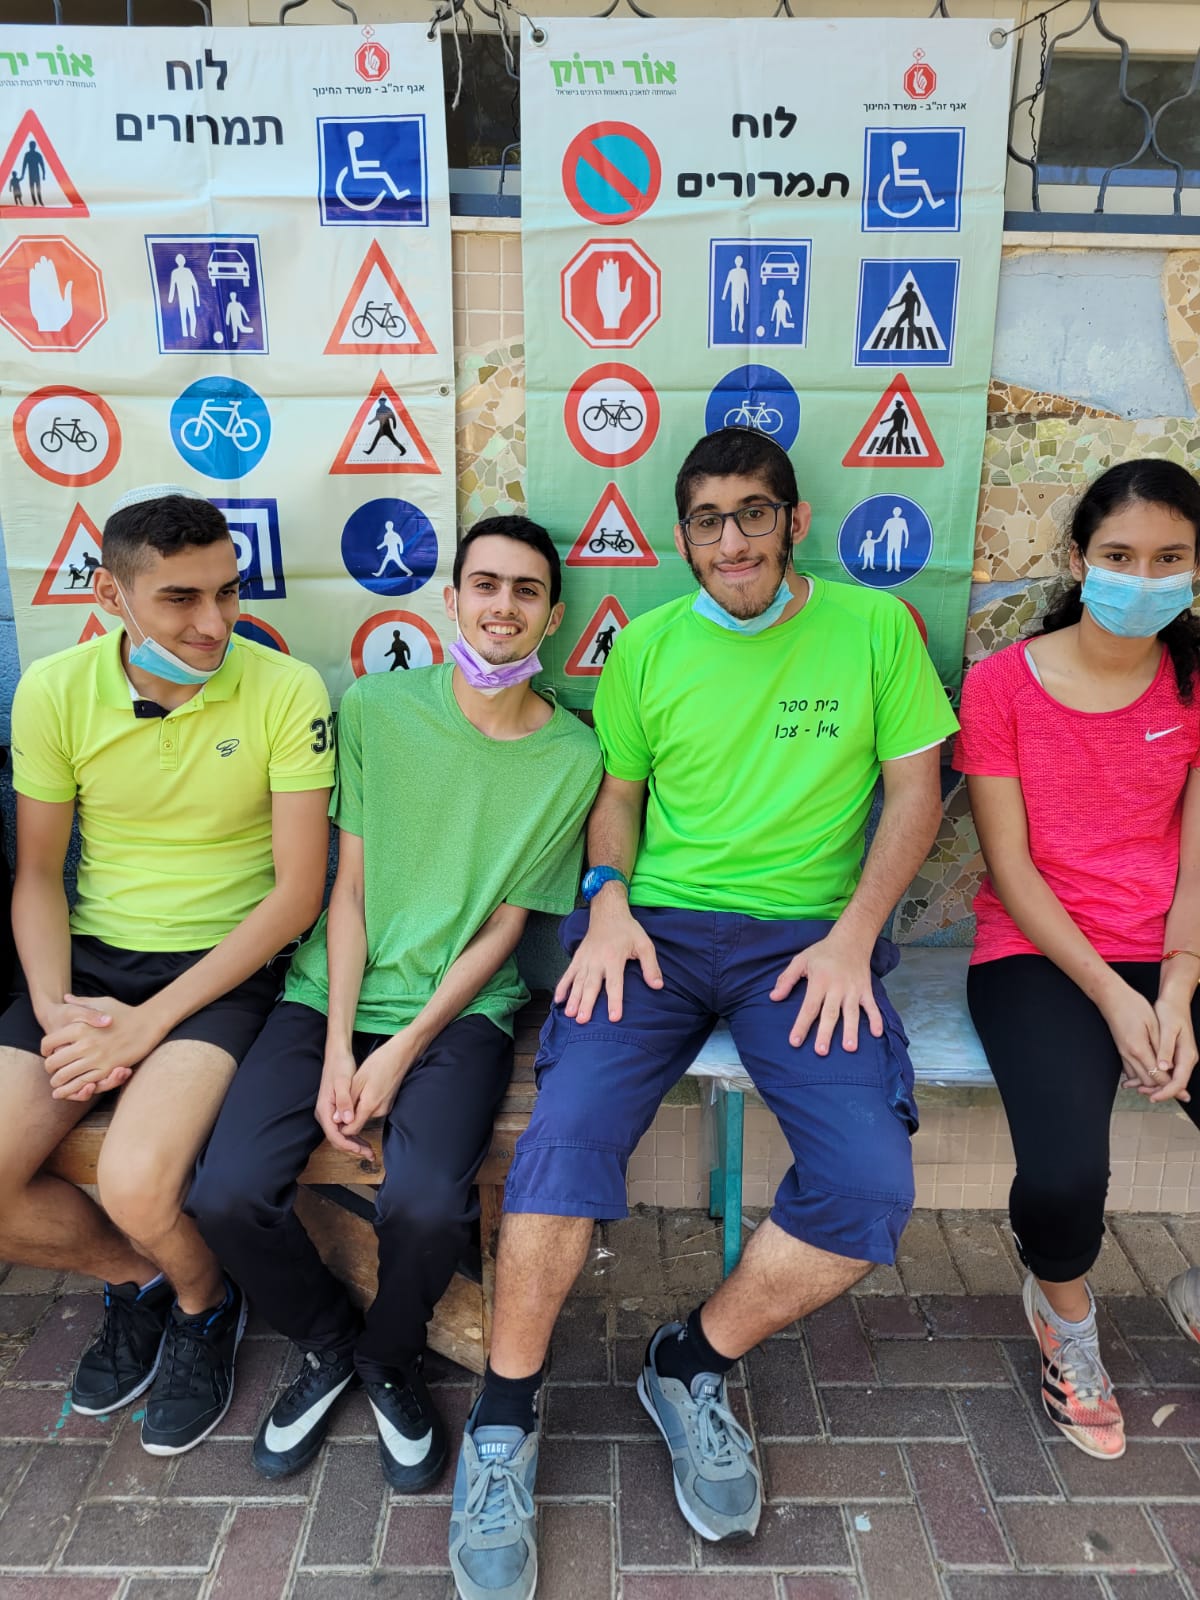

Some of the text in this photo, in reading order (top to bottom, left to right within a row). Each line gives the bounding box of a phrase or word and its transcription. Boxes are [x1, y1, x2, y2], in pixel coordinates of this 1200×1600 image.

[166, 48, 228, 91] לוח
[312, 86, 342, 97] החינוך
[344, 86, 372, 95] משרד
[381, 83, 404, 94] זה"ב
[407, 83, 425, 94] אגף
[863, 103, 890, 112] החינוך
[892, 103, 917, 111] משרד
[925, 101, 947, 111] זה"ב
[949, 102, 967, 112] אגף
[732, 105, 798, 138] לוח
[116, 113, 284, 145] תמרורים
[677, 171, 850, 198] תמרורים
[778, 699, 839, 713] בית ספר
[774, 723, 799, 740] עכו
[816, 719, 840, 738] אייל
